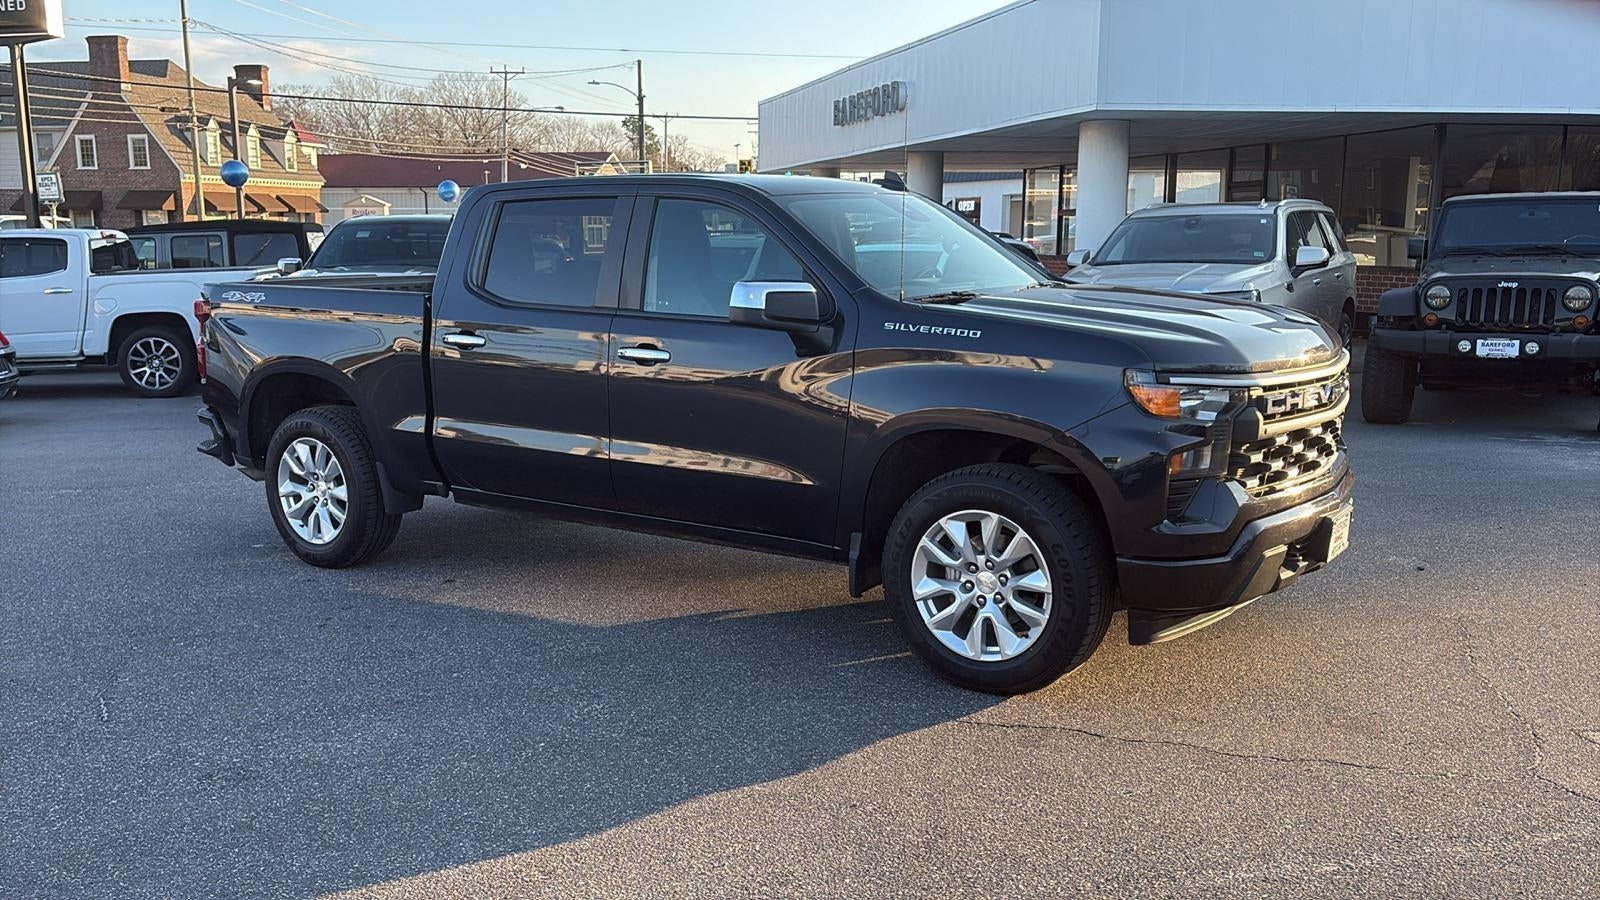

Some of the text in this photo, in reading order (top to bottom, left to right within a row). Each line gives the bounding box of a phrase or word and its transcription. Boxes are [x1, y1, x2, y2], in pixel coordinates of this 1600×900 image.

[833, 80, 907, 126] BAREFORD
[958, 200, 975, 211] OPEN
[884, 322, 982, 338] SILVERADO
